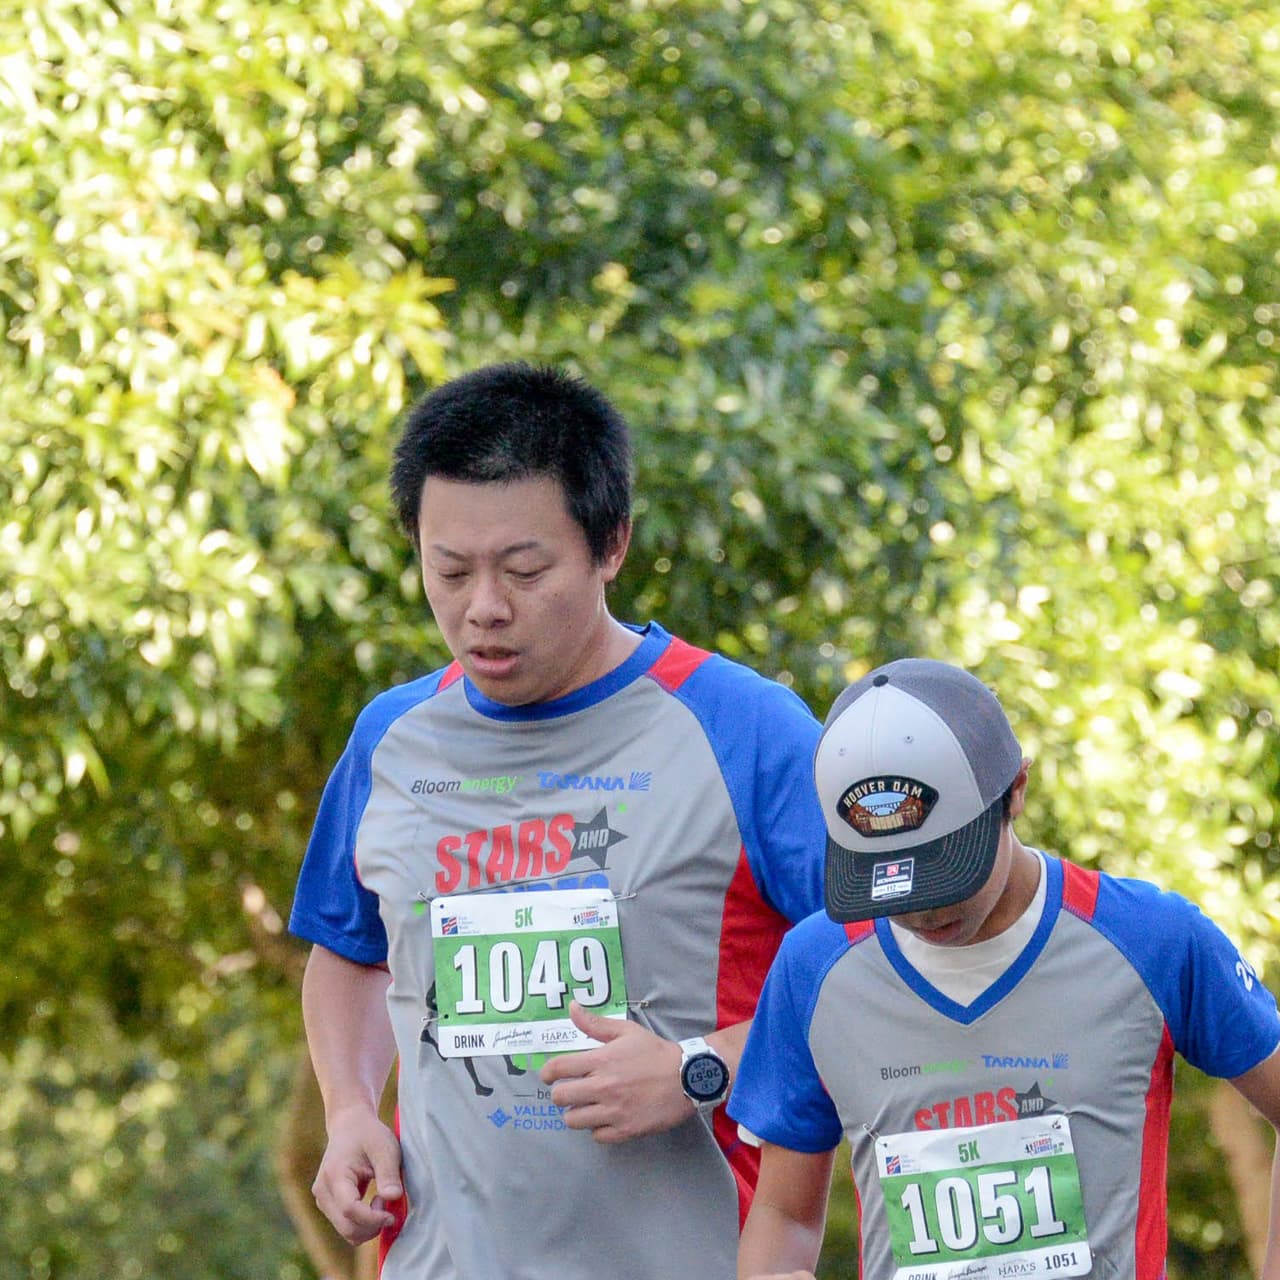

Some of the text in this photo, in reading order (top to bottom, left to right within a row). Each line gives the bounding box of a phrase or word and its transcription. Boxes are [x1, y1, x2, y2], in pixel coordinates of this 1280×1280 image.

[536, 771, 624, 791] TARANA
[843, 781, 923, 808] HOOVER DAM
[435, 813, 576, 894] STARS
[578, 828, 609, 850] AND
[515, 906, 534, 928] 5K
[452, 937, 612, 1016] 1049
[454, 1034, 486, 1049] DRINK
[541, 1030, 578, 1041] HAPA'S
[981, 1055, 1050, 1069] TARANA
[914, 1087, 1044, 1131] STARS AND
[513, 1119, 567, 1130] FOUND
[958, 1140, 980, 1163] 5K
[900, 1166, 1067, 1256] 1051
[998, 1263, 1037, 1276] HAPA'S
[1044, 1253, 1078, 1270] 1051
